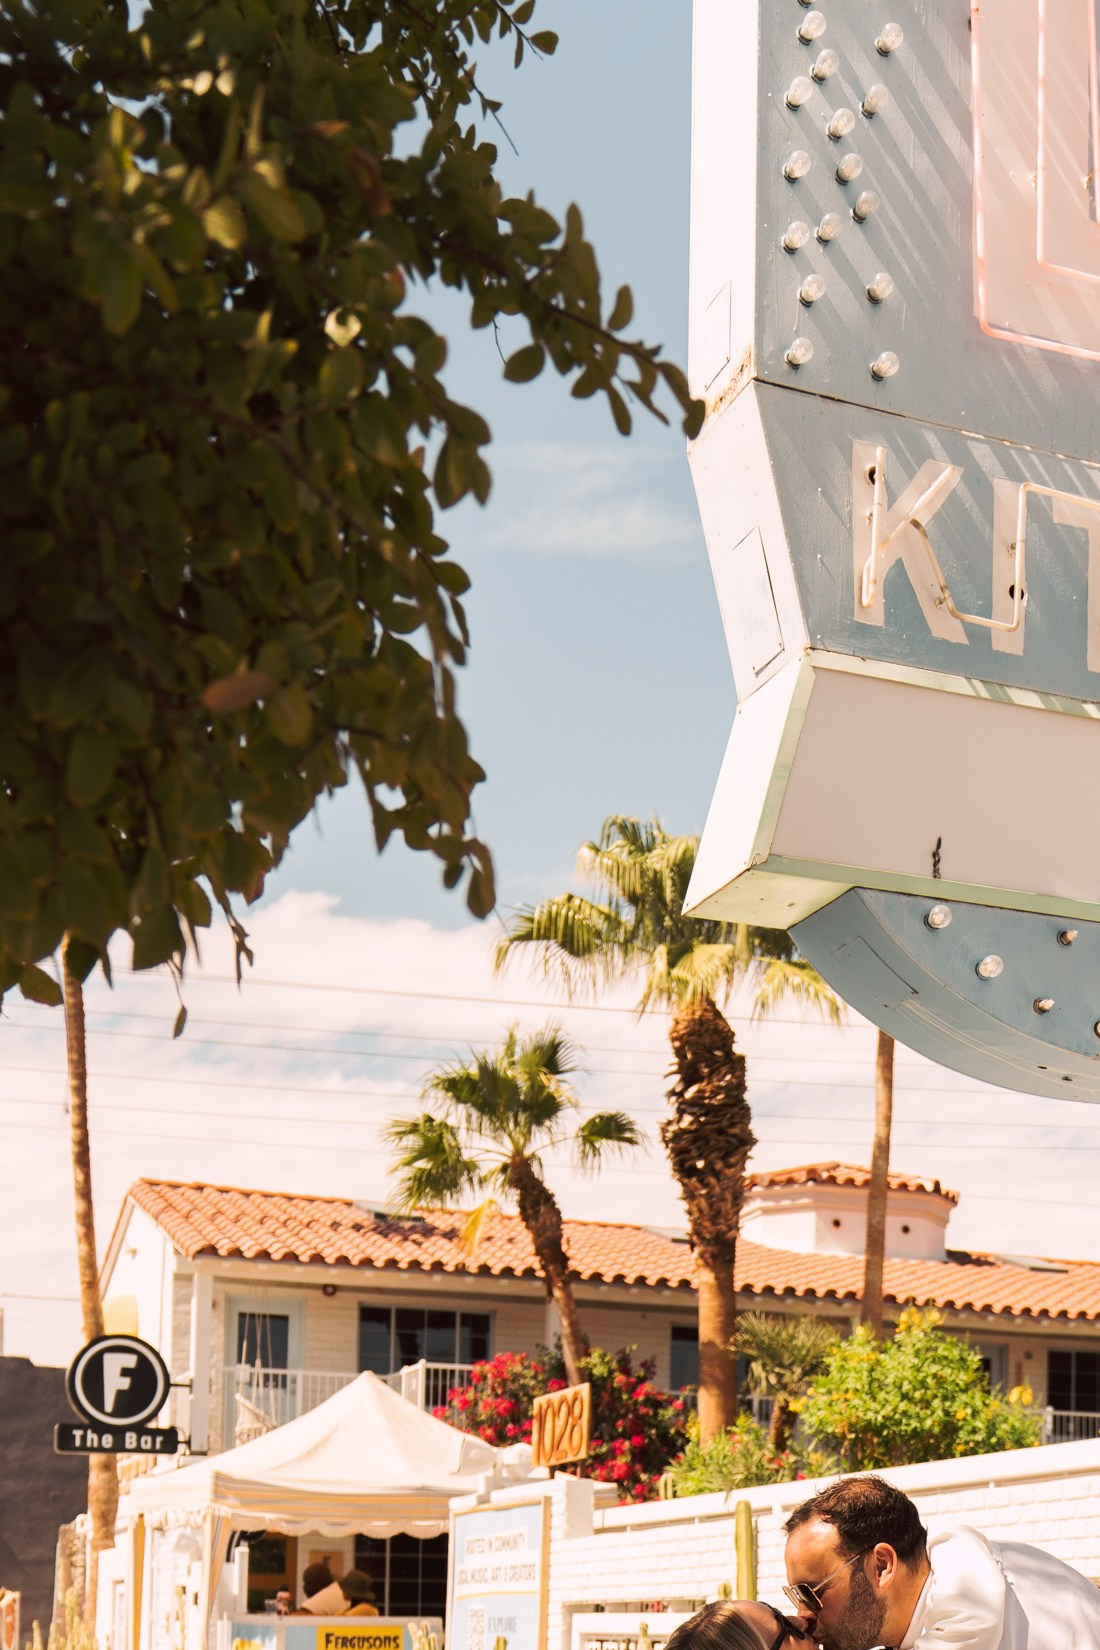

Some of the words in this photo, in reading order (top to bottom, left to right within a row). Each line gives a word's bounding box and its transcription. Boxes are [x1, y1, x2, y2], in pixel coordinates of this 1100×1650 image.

[102, 1352, 138, 1414] F
[72, 1429, 114, 1449] The
[124, 1431, 164, 1450] Bar
[533, 1391, 584, 1465] 1028
[488, 1615, 518, 1633] EXPLORE
